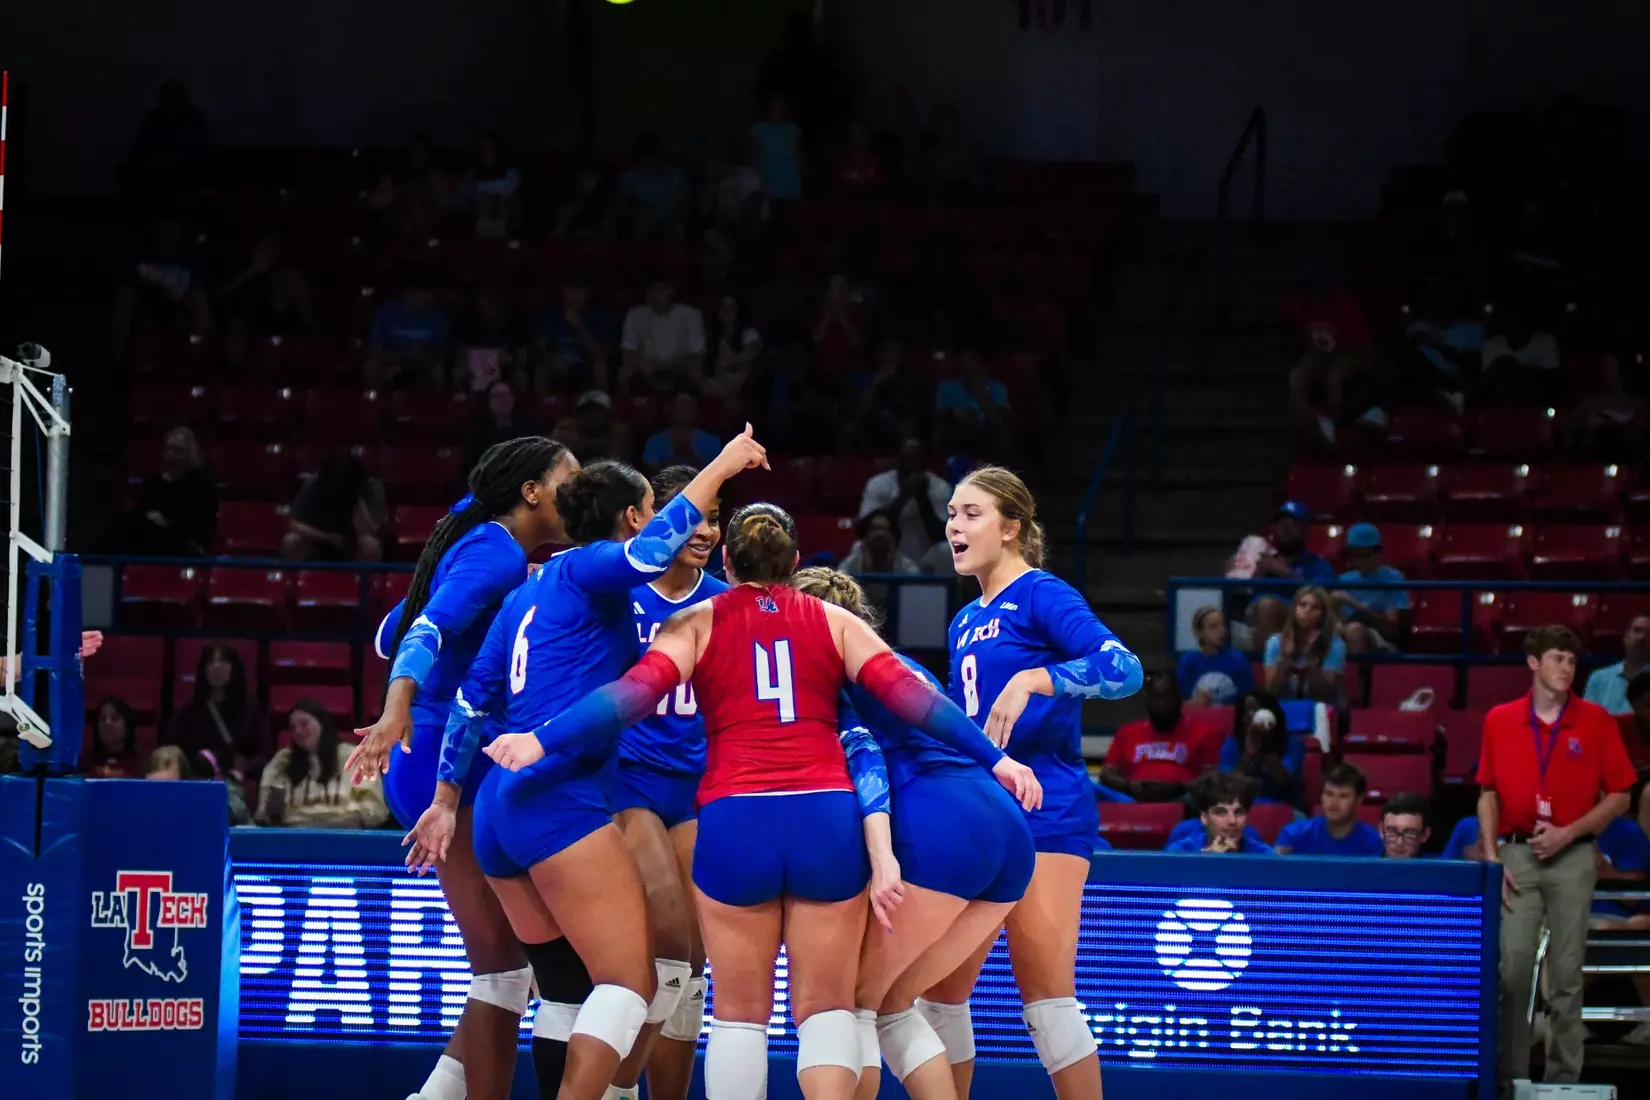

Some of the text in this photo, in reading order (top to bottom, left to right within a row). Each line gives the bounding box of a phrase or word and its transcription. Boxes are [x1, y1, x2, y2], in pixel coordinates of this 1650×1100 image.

[509, 604, 537, 695] 6
[754, 638, 797, 724] 4
[961, 653, 979, 718] 8
[18, 883, 46, 1066] sports imports
[88, 998, 204, 1032] BULLDOGS
[1230, 1006, 1360, 1053] Bank
